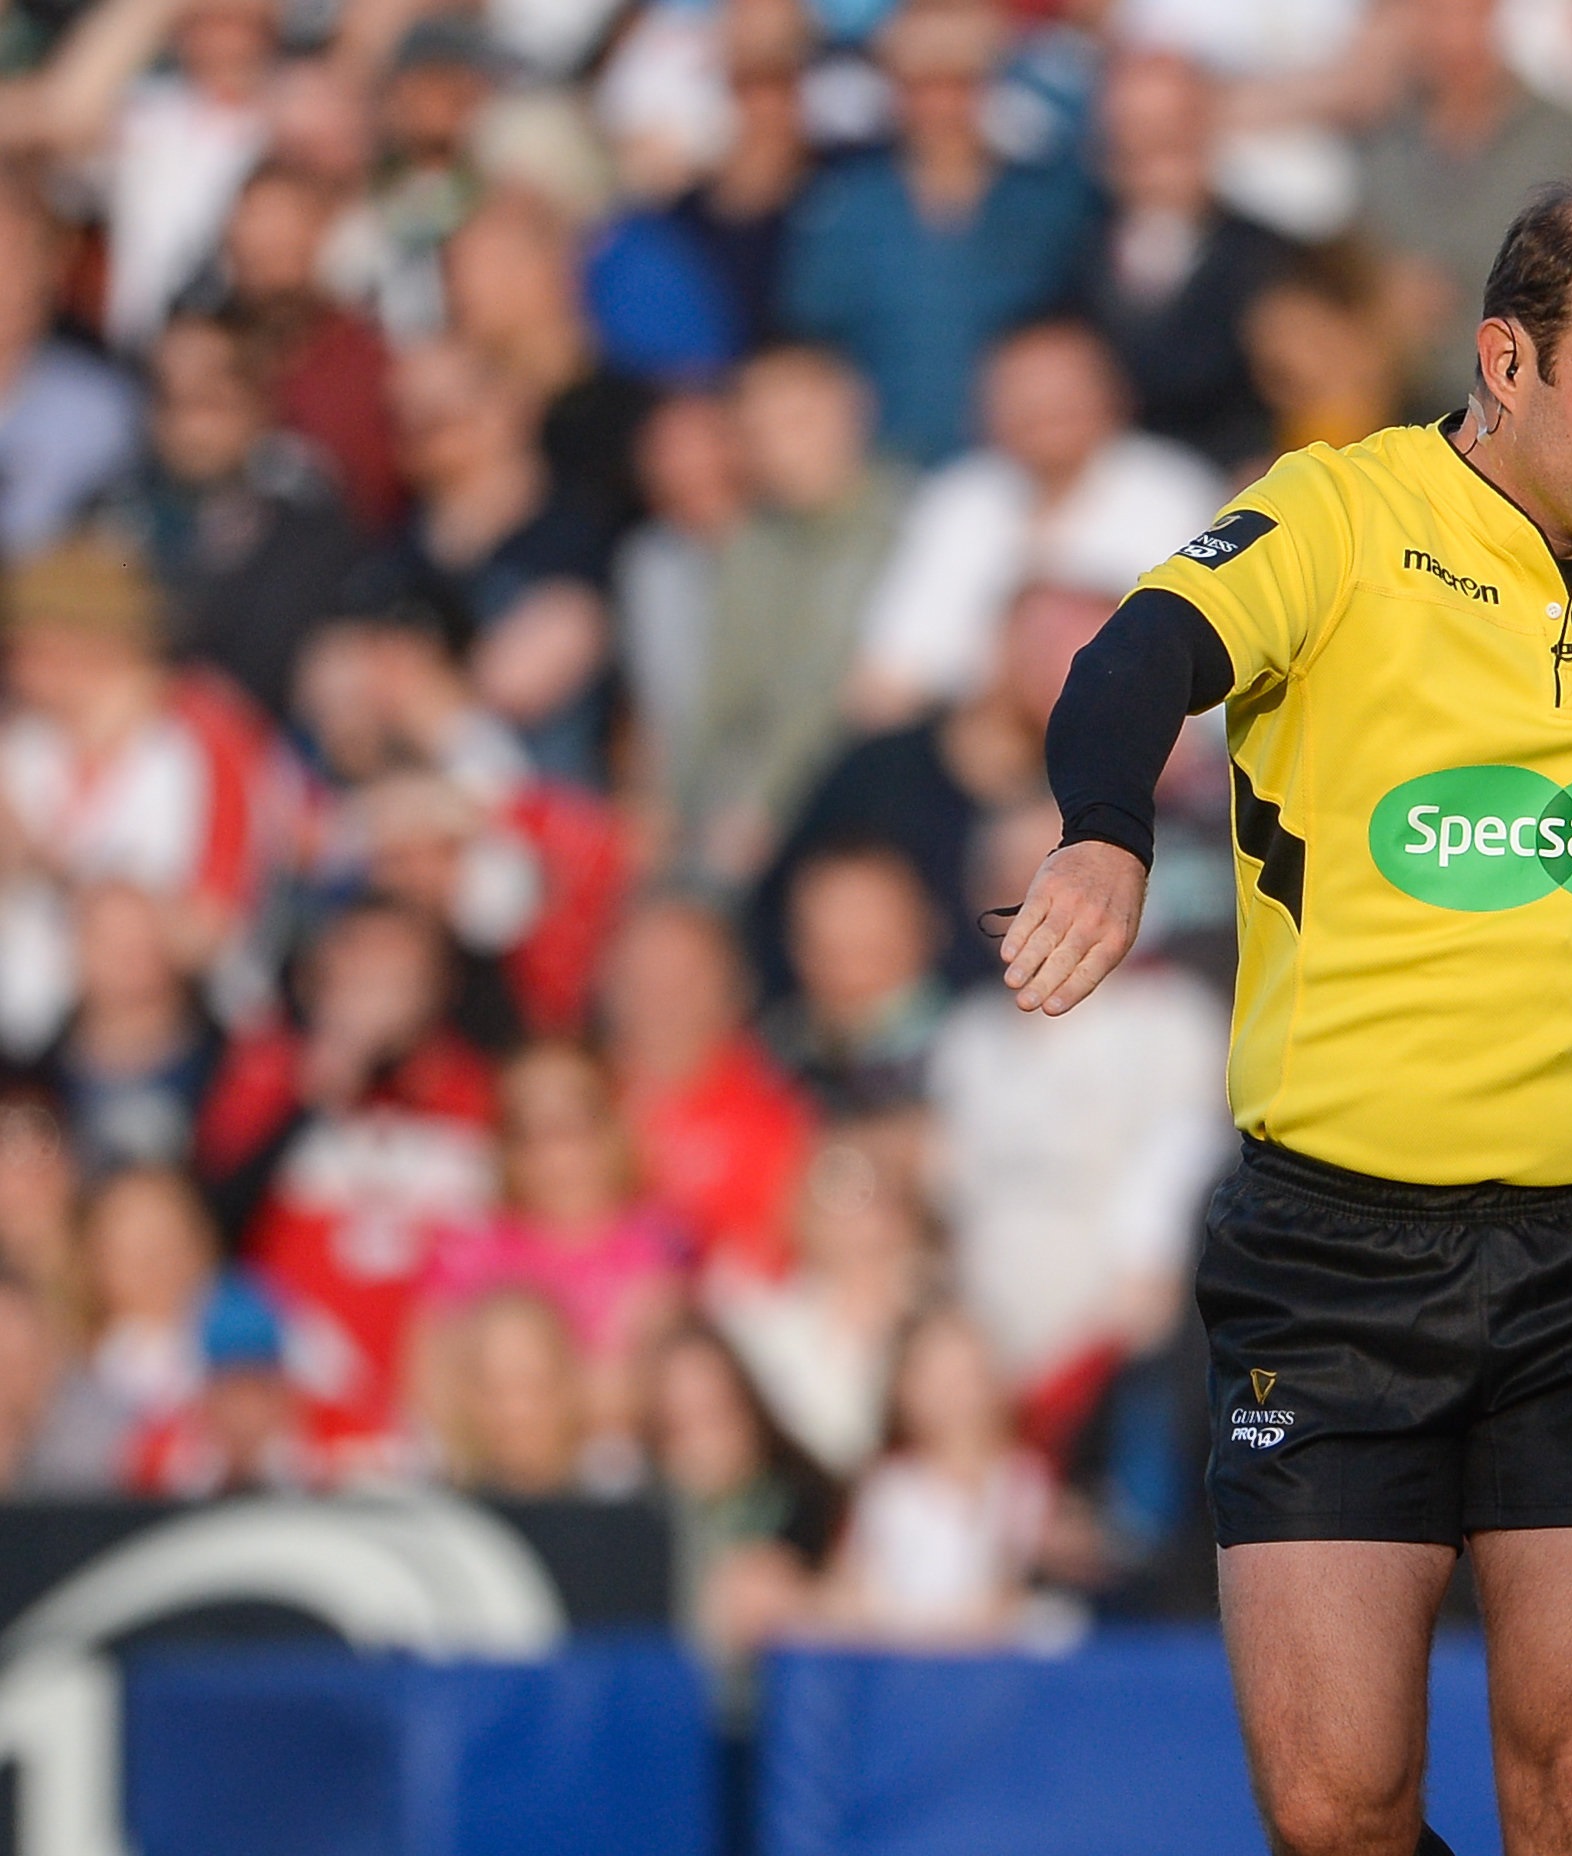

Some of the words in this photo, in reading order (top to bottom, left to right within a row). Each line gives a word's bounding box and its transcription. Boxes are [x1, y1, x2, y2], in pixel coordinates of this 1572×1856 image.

[1197, 533, 1238, 553] NESS
[1403, 548, 1499, 605] macron
[1231, 1407, 1295, 1426] GUINNESS
